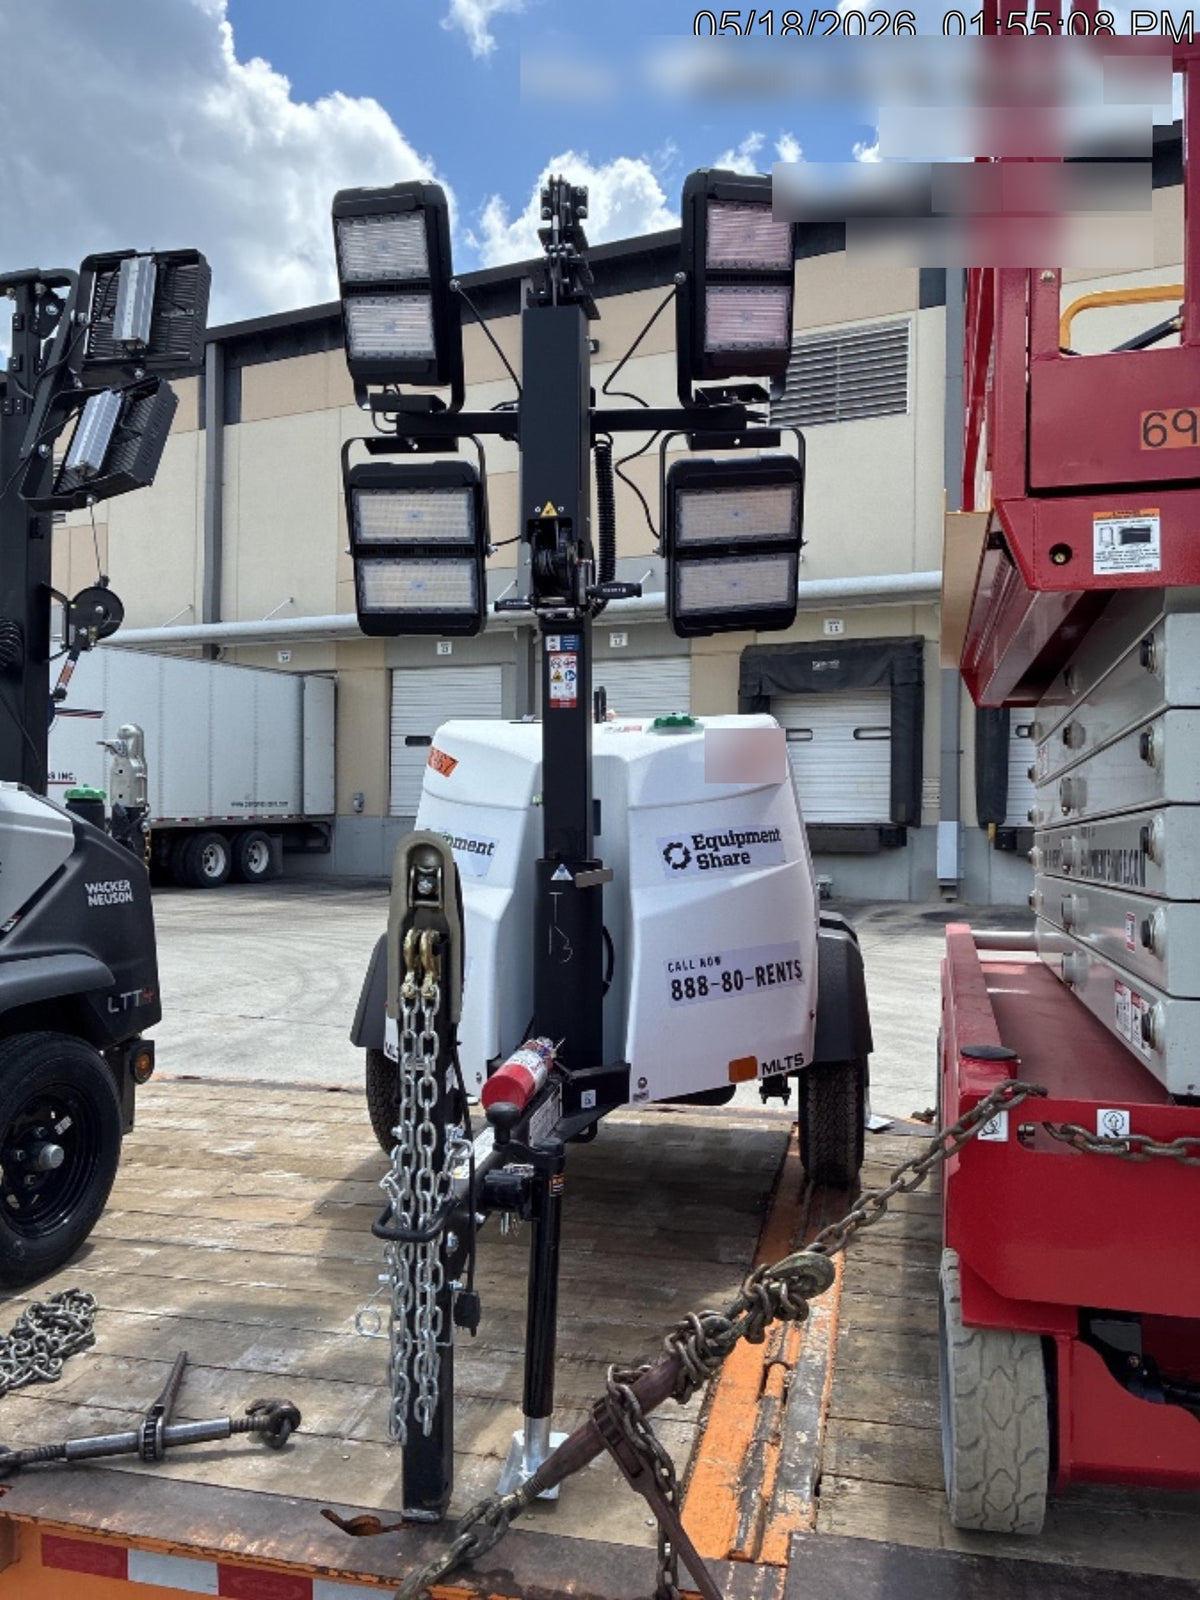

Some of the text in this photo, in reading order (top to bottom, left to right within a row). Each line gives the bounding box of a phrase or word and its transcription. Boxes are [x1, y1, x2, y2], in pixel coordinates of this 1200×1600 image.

[691, 828, 781, 852] Equipment
[696, 852, 751, 870] Share
[85, 880, 131, 894] WACKER
[88, 891, 134, 907] NEUSON
[668, 959, 696, 973] CALL
[671, 959, 803, 1001] 888-80-RENTS
[107, 988, 154, 1013] LTT4
